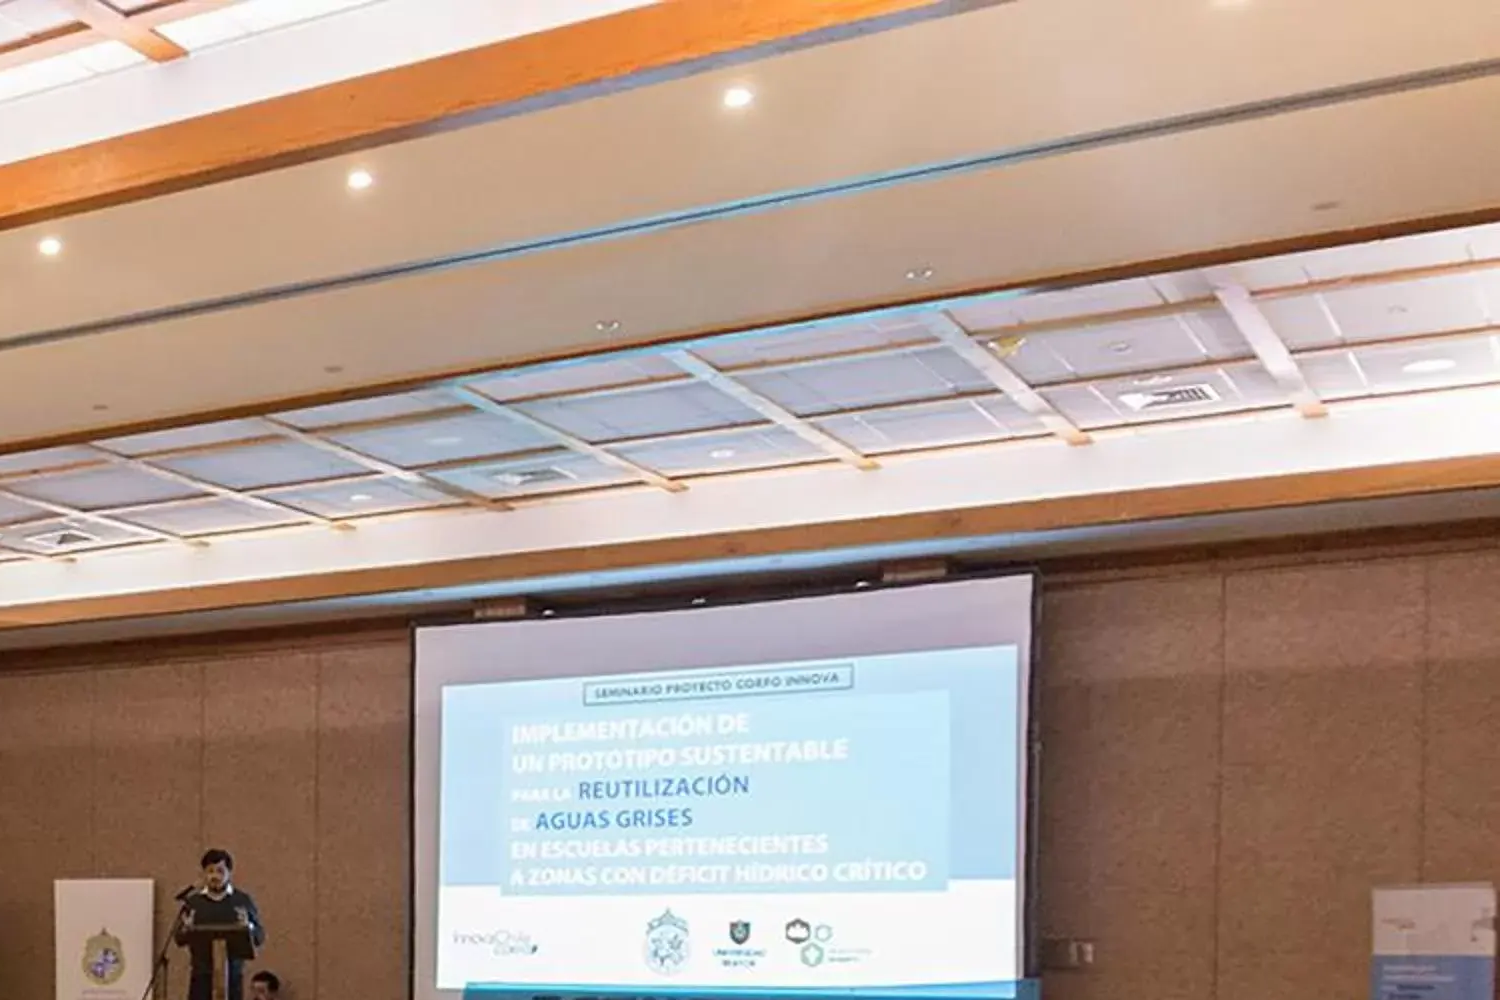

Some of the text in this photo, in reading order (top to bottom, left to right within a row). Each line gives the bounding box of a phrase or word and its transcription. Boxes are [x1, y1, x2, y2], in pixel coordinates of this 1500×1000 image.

[595, 671, 840, 699] SEMINARIO PROYECTO CORFO INNOVA
[512, 713, 749, 746] IMPLEMENTACIÓN DE
[512, 738, 849, 774] UN PROTOTIPO SUSTENTABLE
[578, 773, 750, 800] REUTILIZACIÓN
[535, 810, 610, 831] AGUAS
[616, 808, 693, 828] GRISES
[511, 834, 828, 859] EN ESCUELAS PERTENECIENTES
[510, 857, 927, 886] A ZONAS CON DÉFICIT HÍDRICO CRÍTICO
